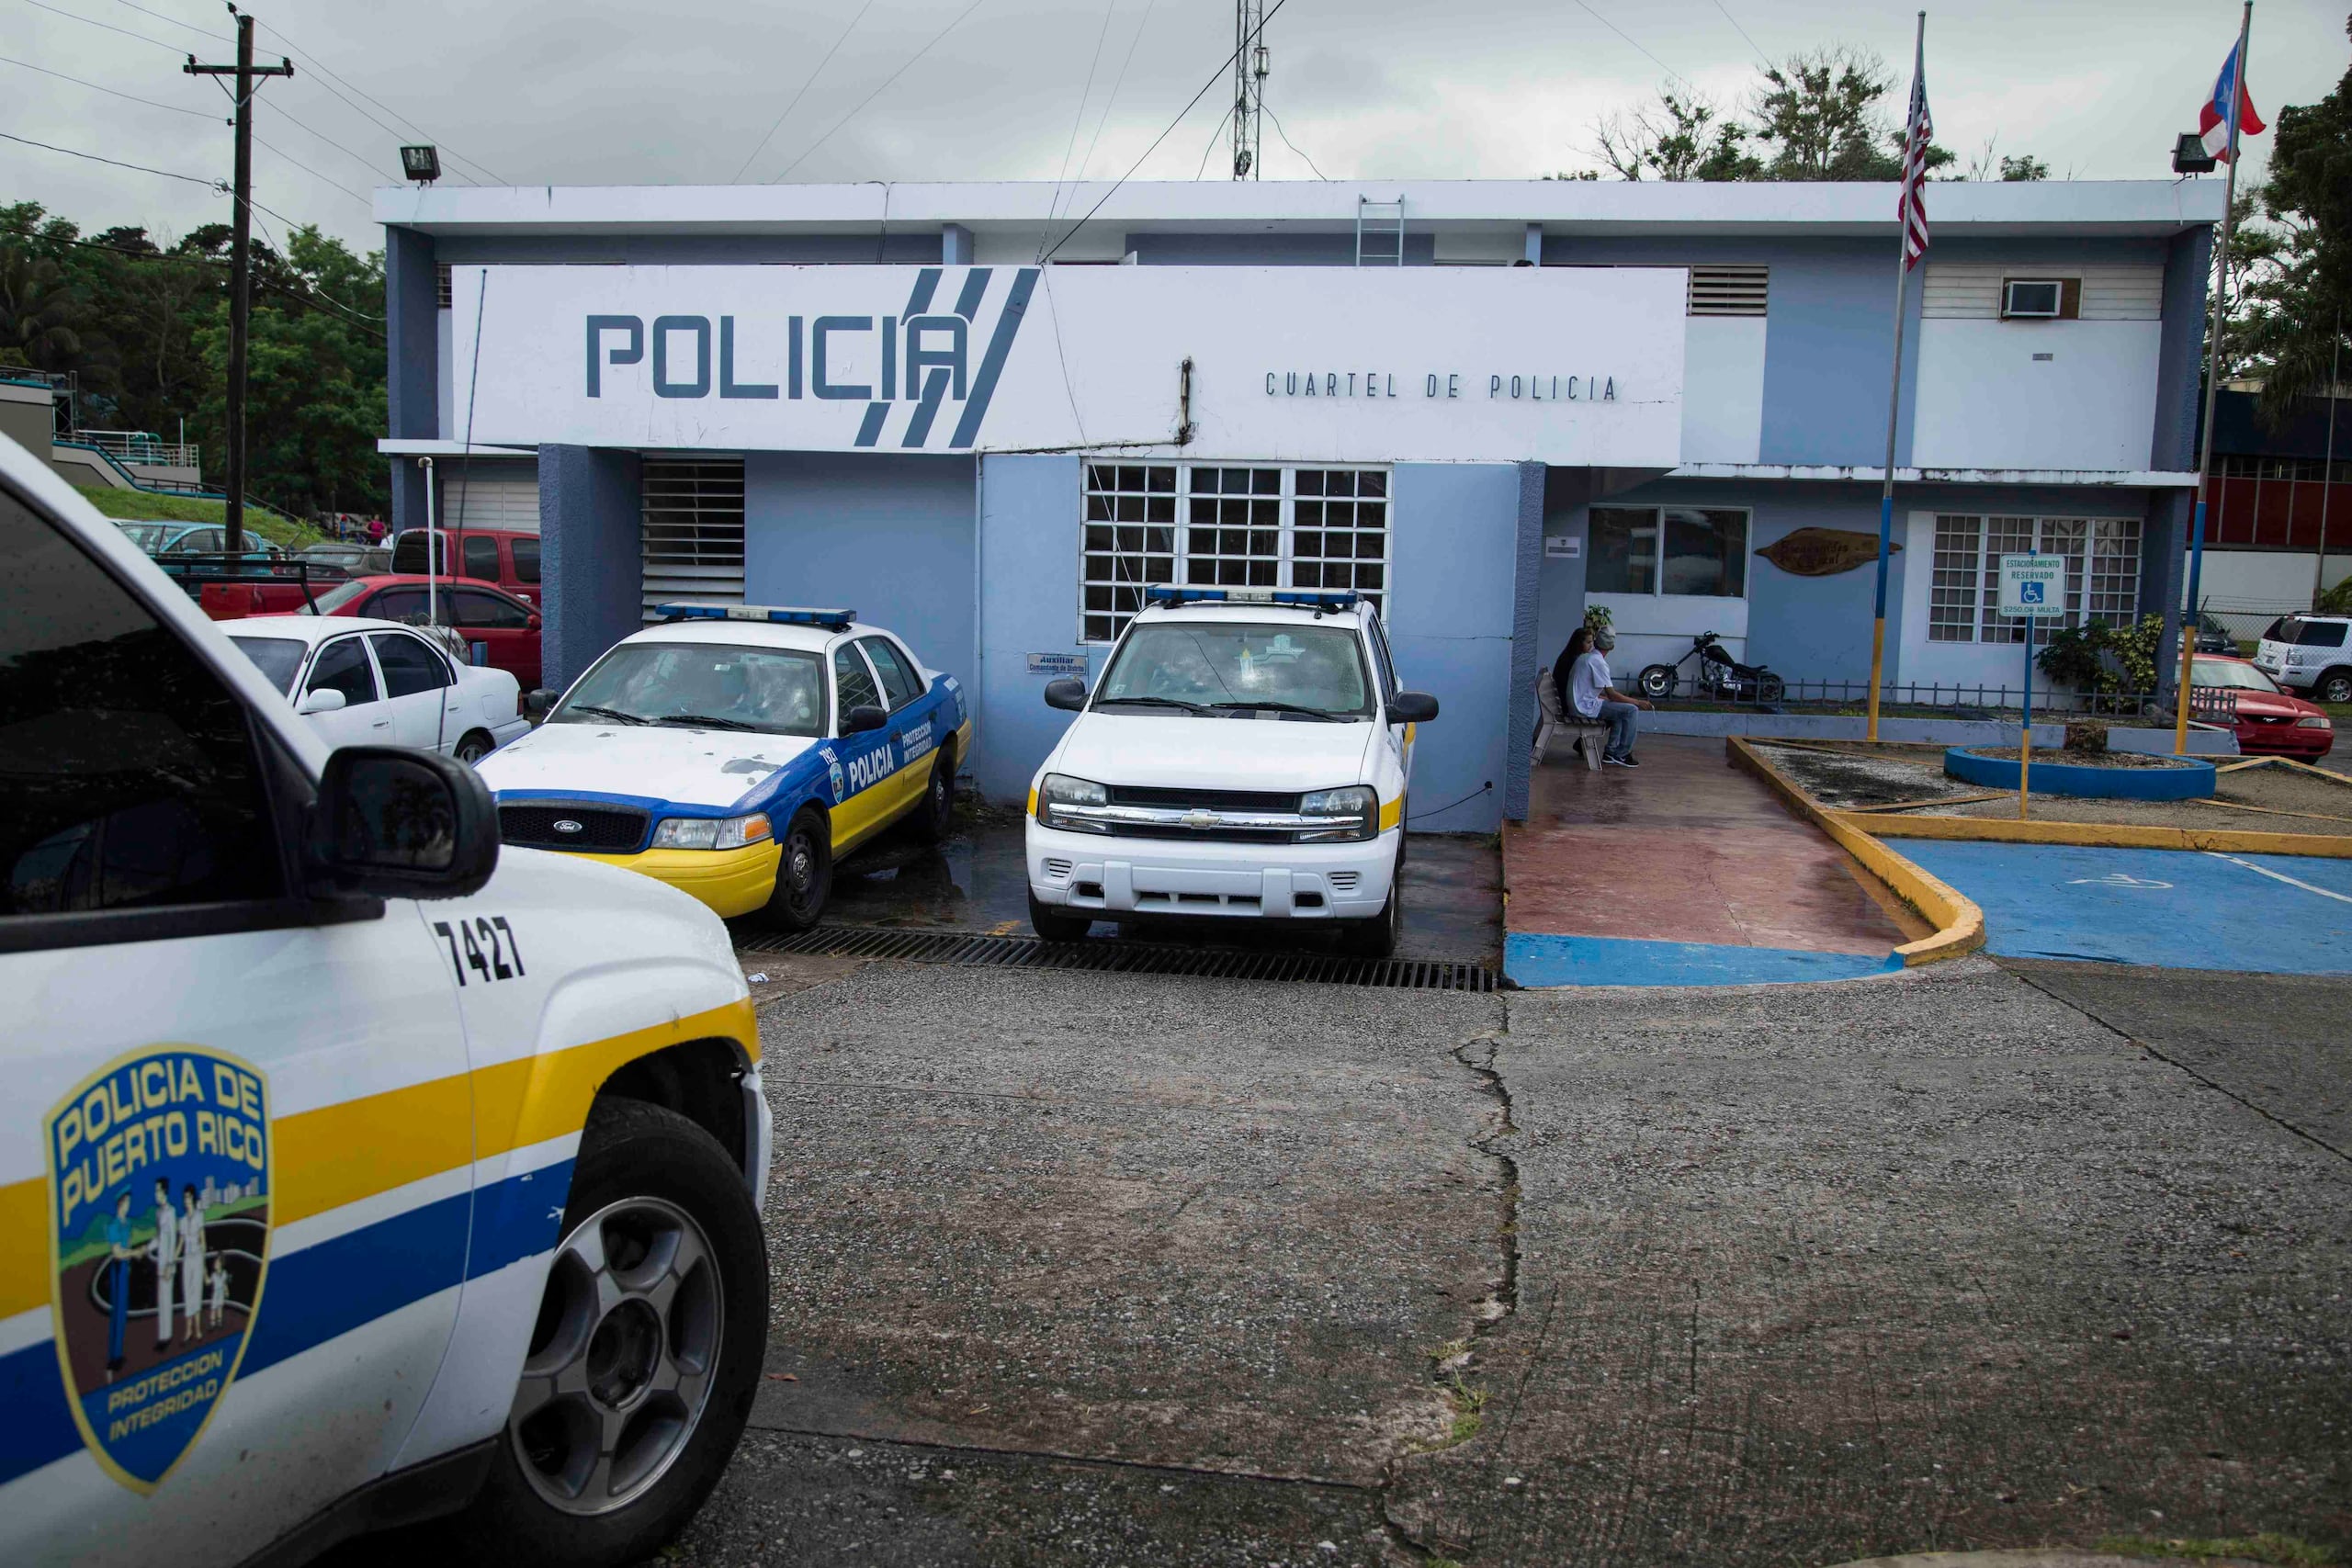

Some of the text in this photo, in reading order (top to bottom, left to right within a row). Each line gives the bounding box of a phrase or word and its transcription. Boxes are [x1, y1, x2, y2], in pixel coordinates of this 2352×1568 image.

[586, 314, 967, 400] POLICIA
[1266, 372, 1615, 400] CUARTEL DE POLICIA
[2007, 559, 2060, 568] ESTACIONAMIENTO
[2037, 605, 2060, 614] MULTA
[902, 720, 932, 748] PROTECCION
[903, 737, 933, 763] INTEGRIDAD
[848, 743, 895, 792] POLICIA
[433, 916, 526, 987] 7427
[58, 1058, 262, 1168] POLICIA DE
[61, 1109, 266, 1227] PUERTO RICO
[107, 1348, 223, 1415] PROTECCION
[108, 1378, 218, 1442] INTEGRIDAD
